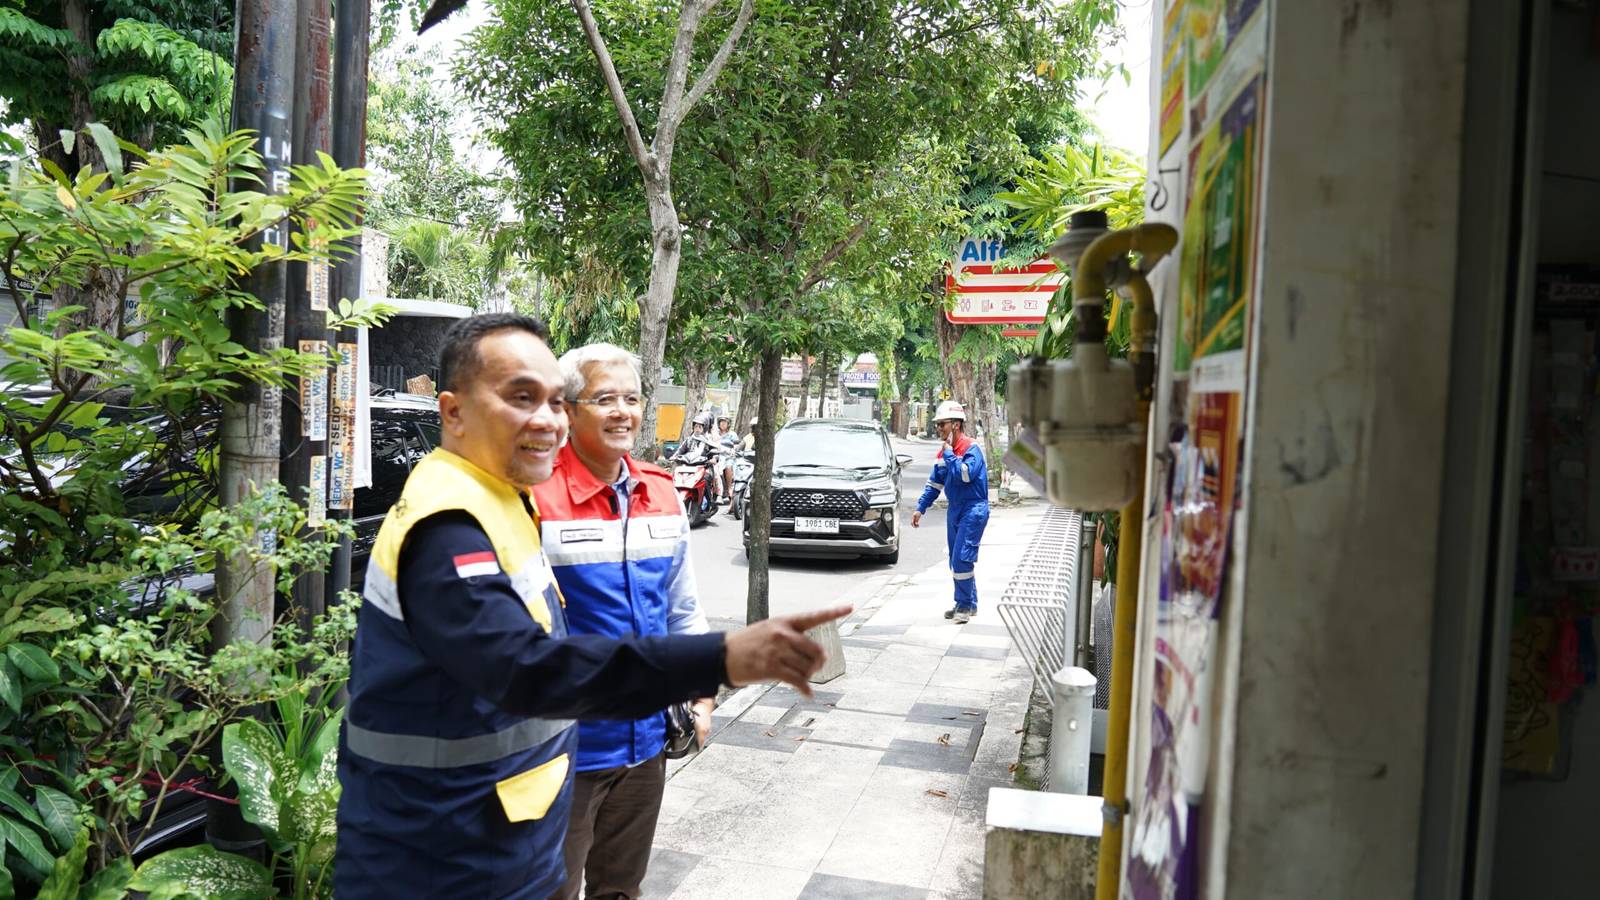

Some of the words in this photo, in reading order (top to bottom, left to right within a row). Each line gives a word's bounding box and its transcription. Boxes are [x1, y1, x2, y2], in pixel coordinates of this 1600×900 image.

[340, 346, 350, 366] WC
[340, 371, 350, 401] SEDOT
[333, 451, 344, 470] WC
[332, 475, 342, 505] SEDOT
